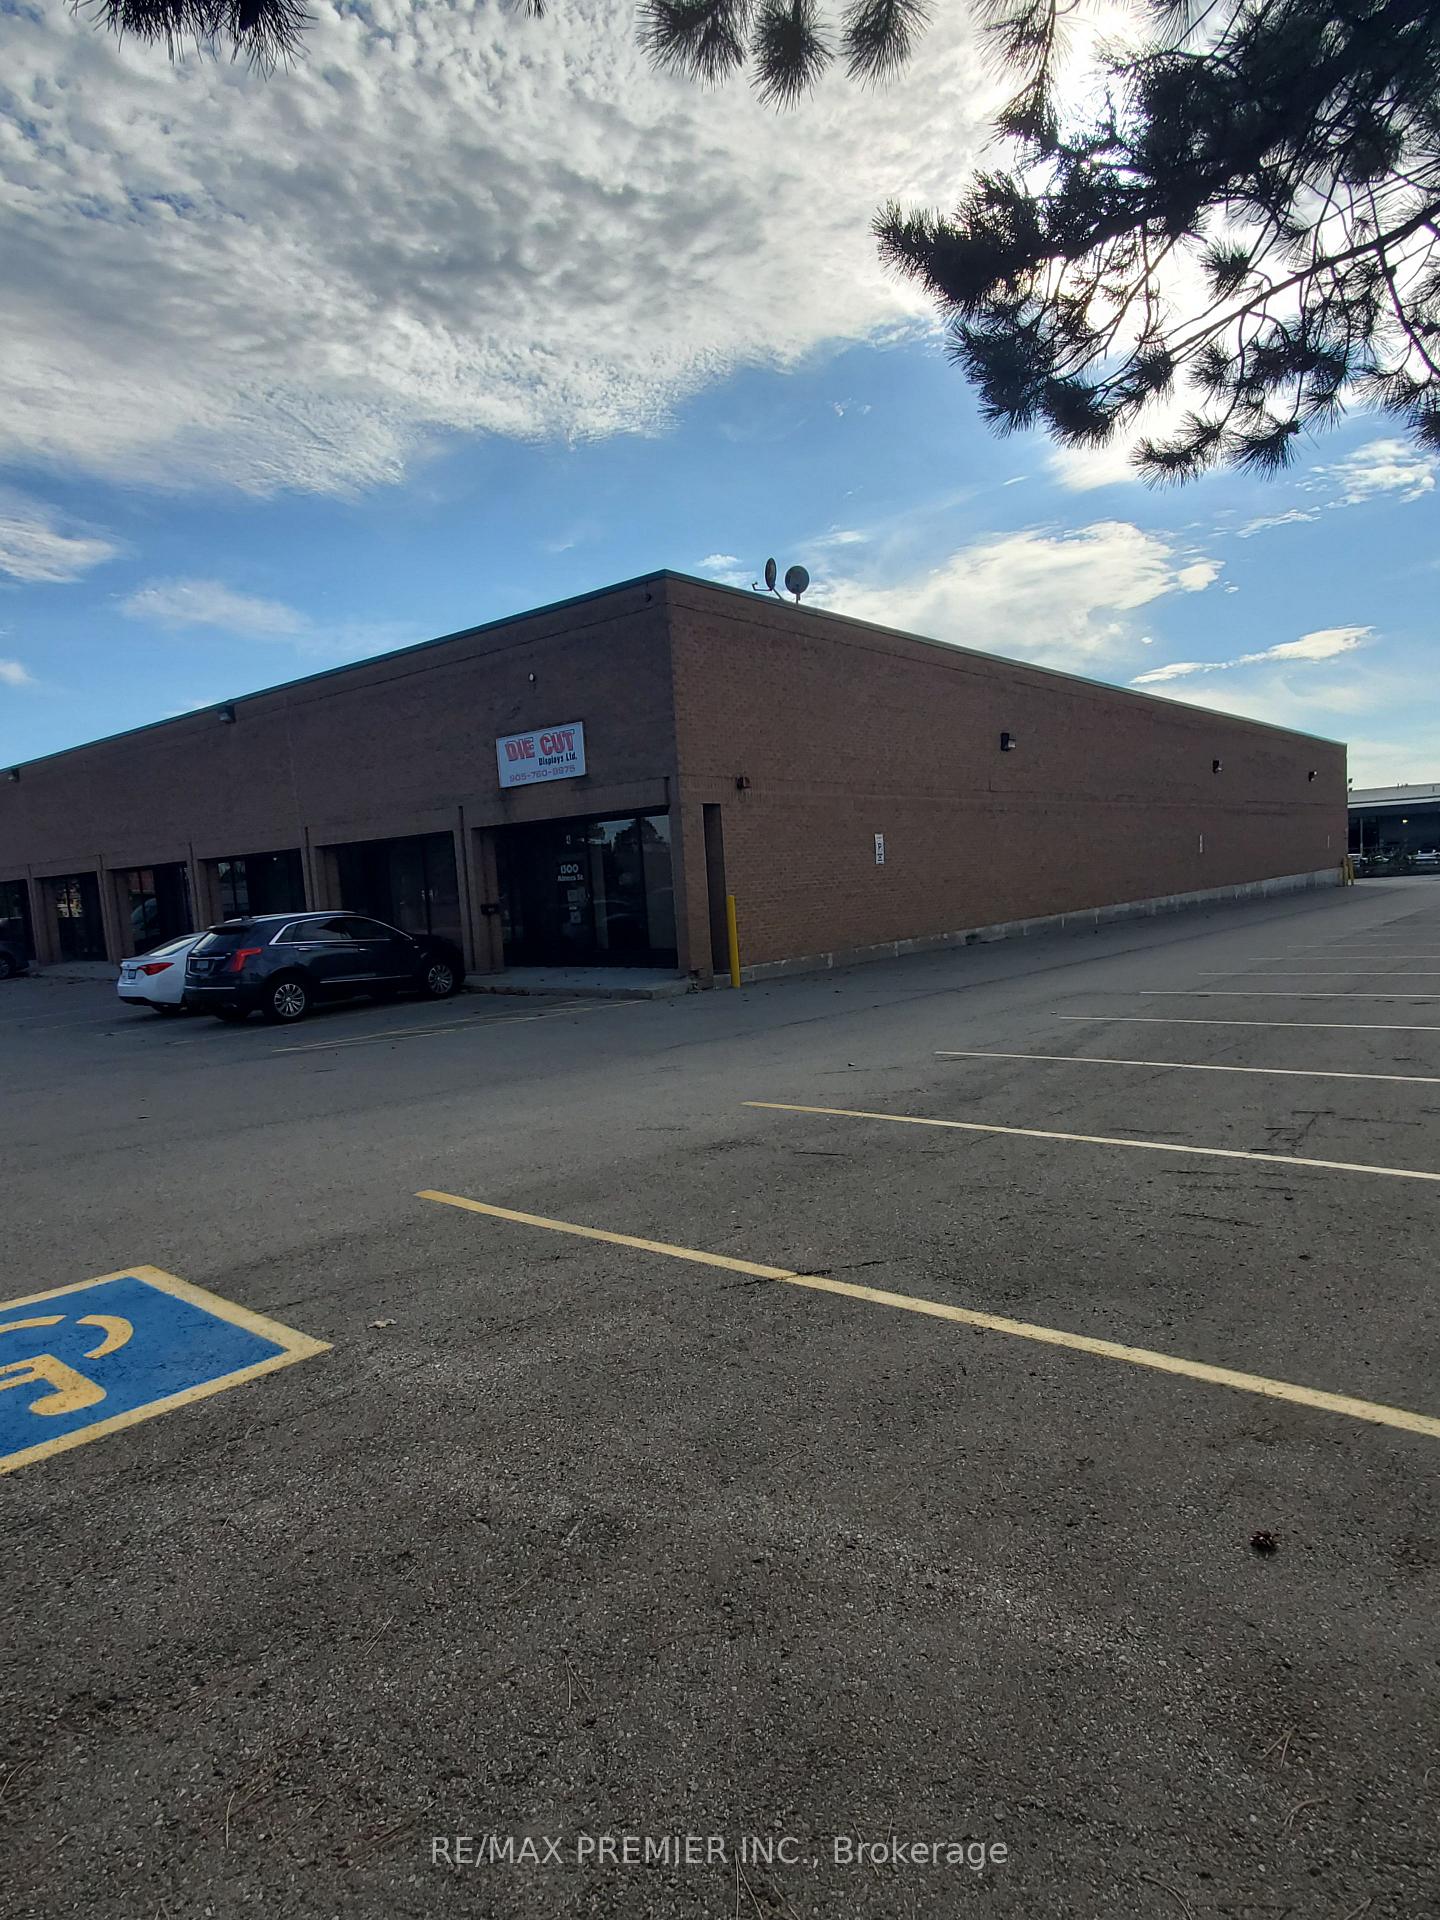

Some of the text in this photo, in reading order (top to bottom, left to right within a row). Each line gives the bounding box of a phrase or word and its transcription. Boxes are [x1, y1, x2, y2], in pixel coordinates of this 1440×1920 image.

[505, 729, 575, 761] DIE CUT
[538, 756, 564, 766] Displays
